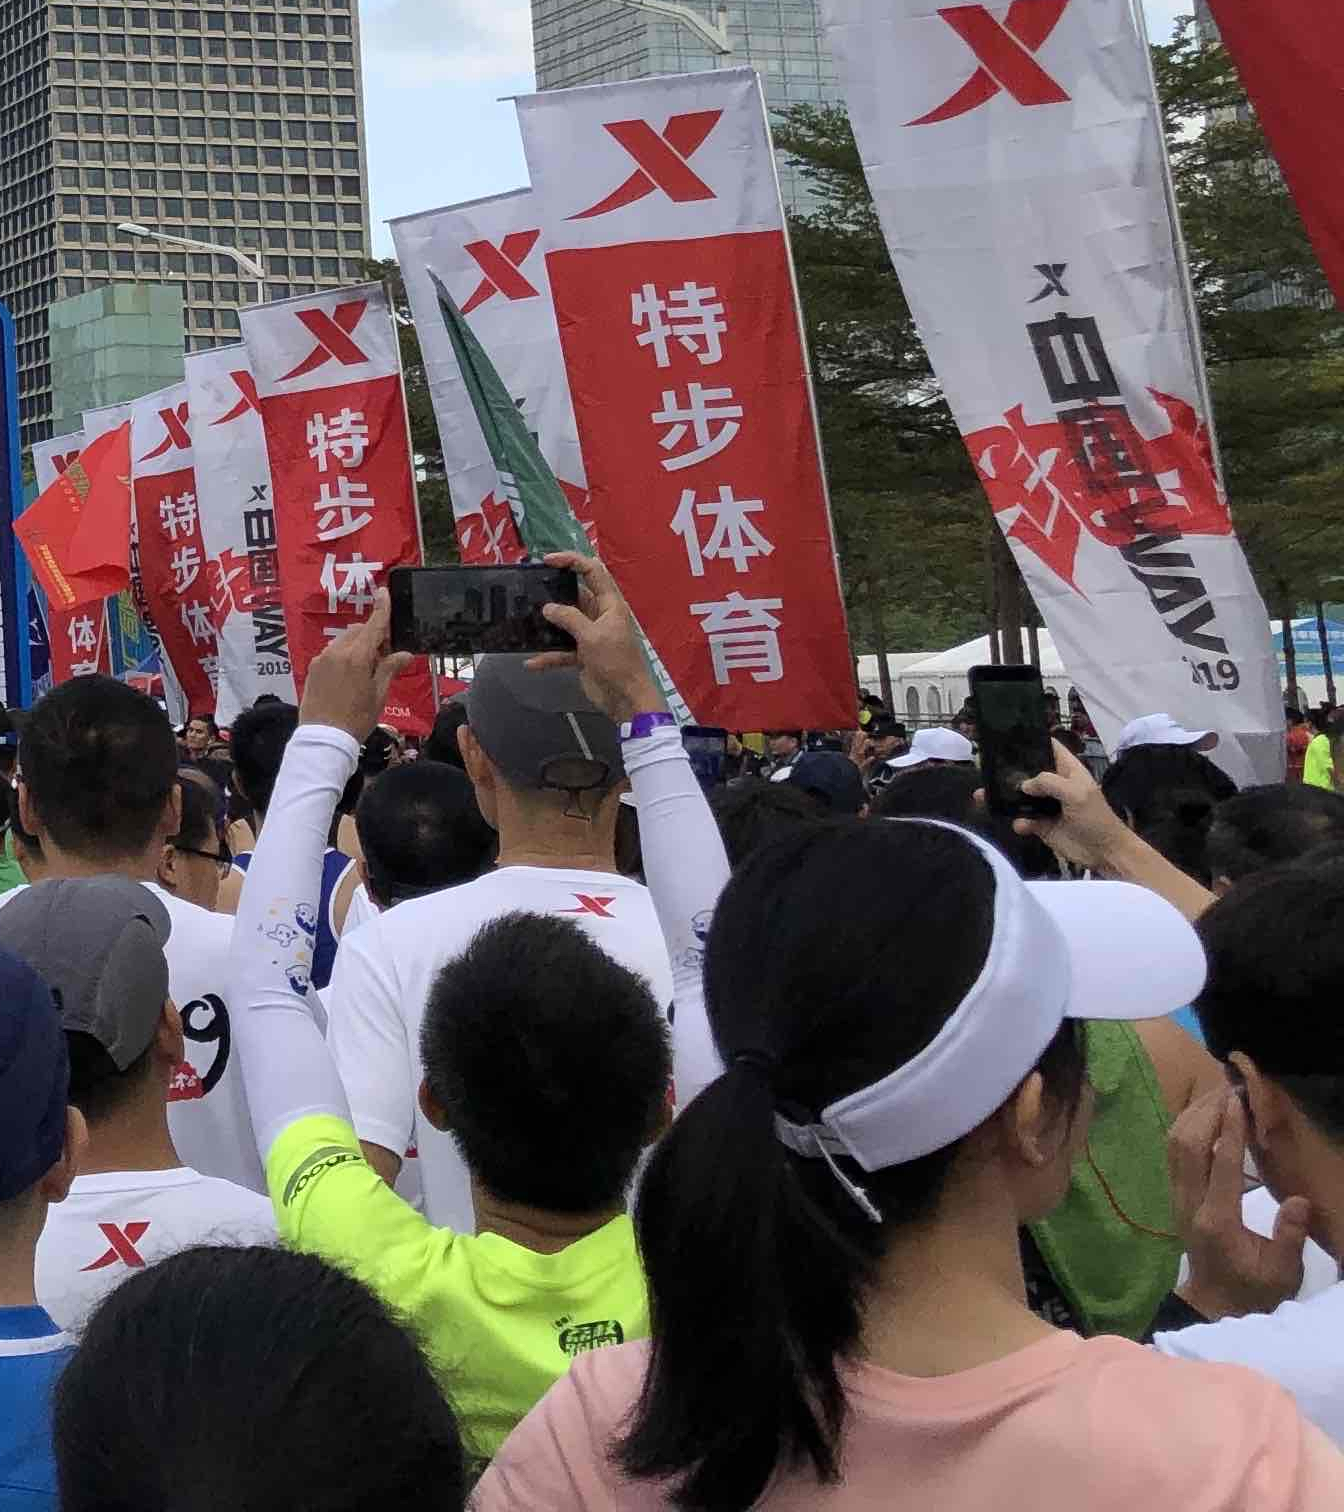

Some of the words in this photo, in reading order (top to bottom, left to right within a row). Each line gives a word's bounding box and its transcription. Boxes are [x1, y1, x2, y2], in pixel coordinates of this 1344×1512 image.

[306, 406, 385, 638] 特步体
[630, 280, 785, 686] 特步体育
[256, 661, 292, 676] 2019
